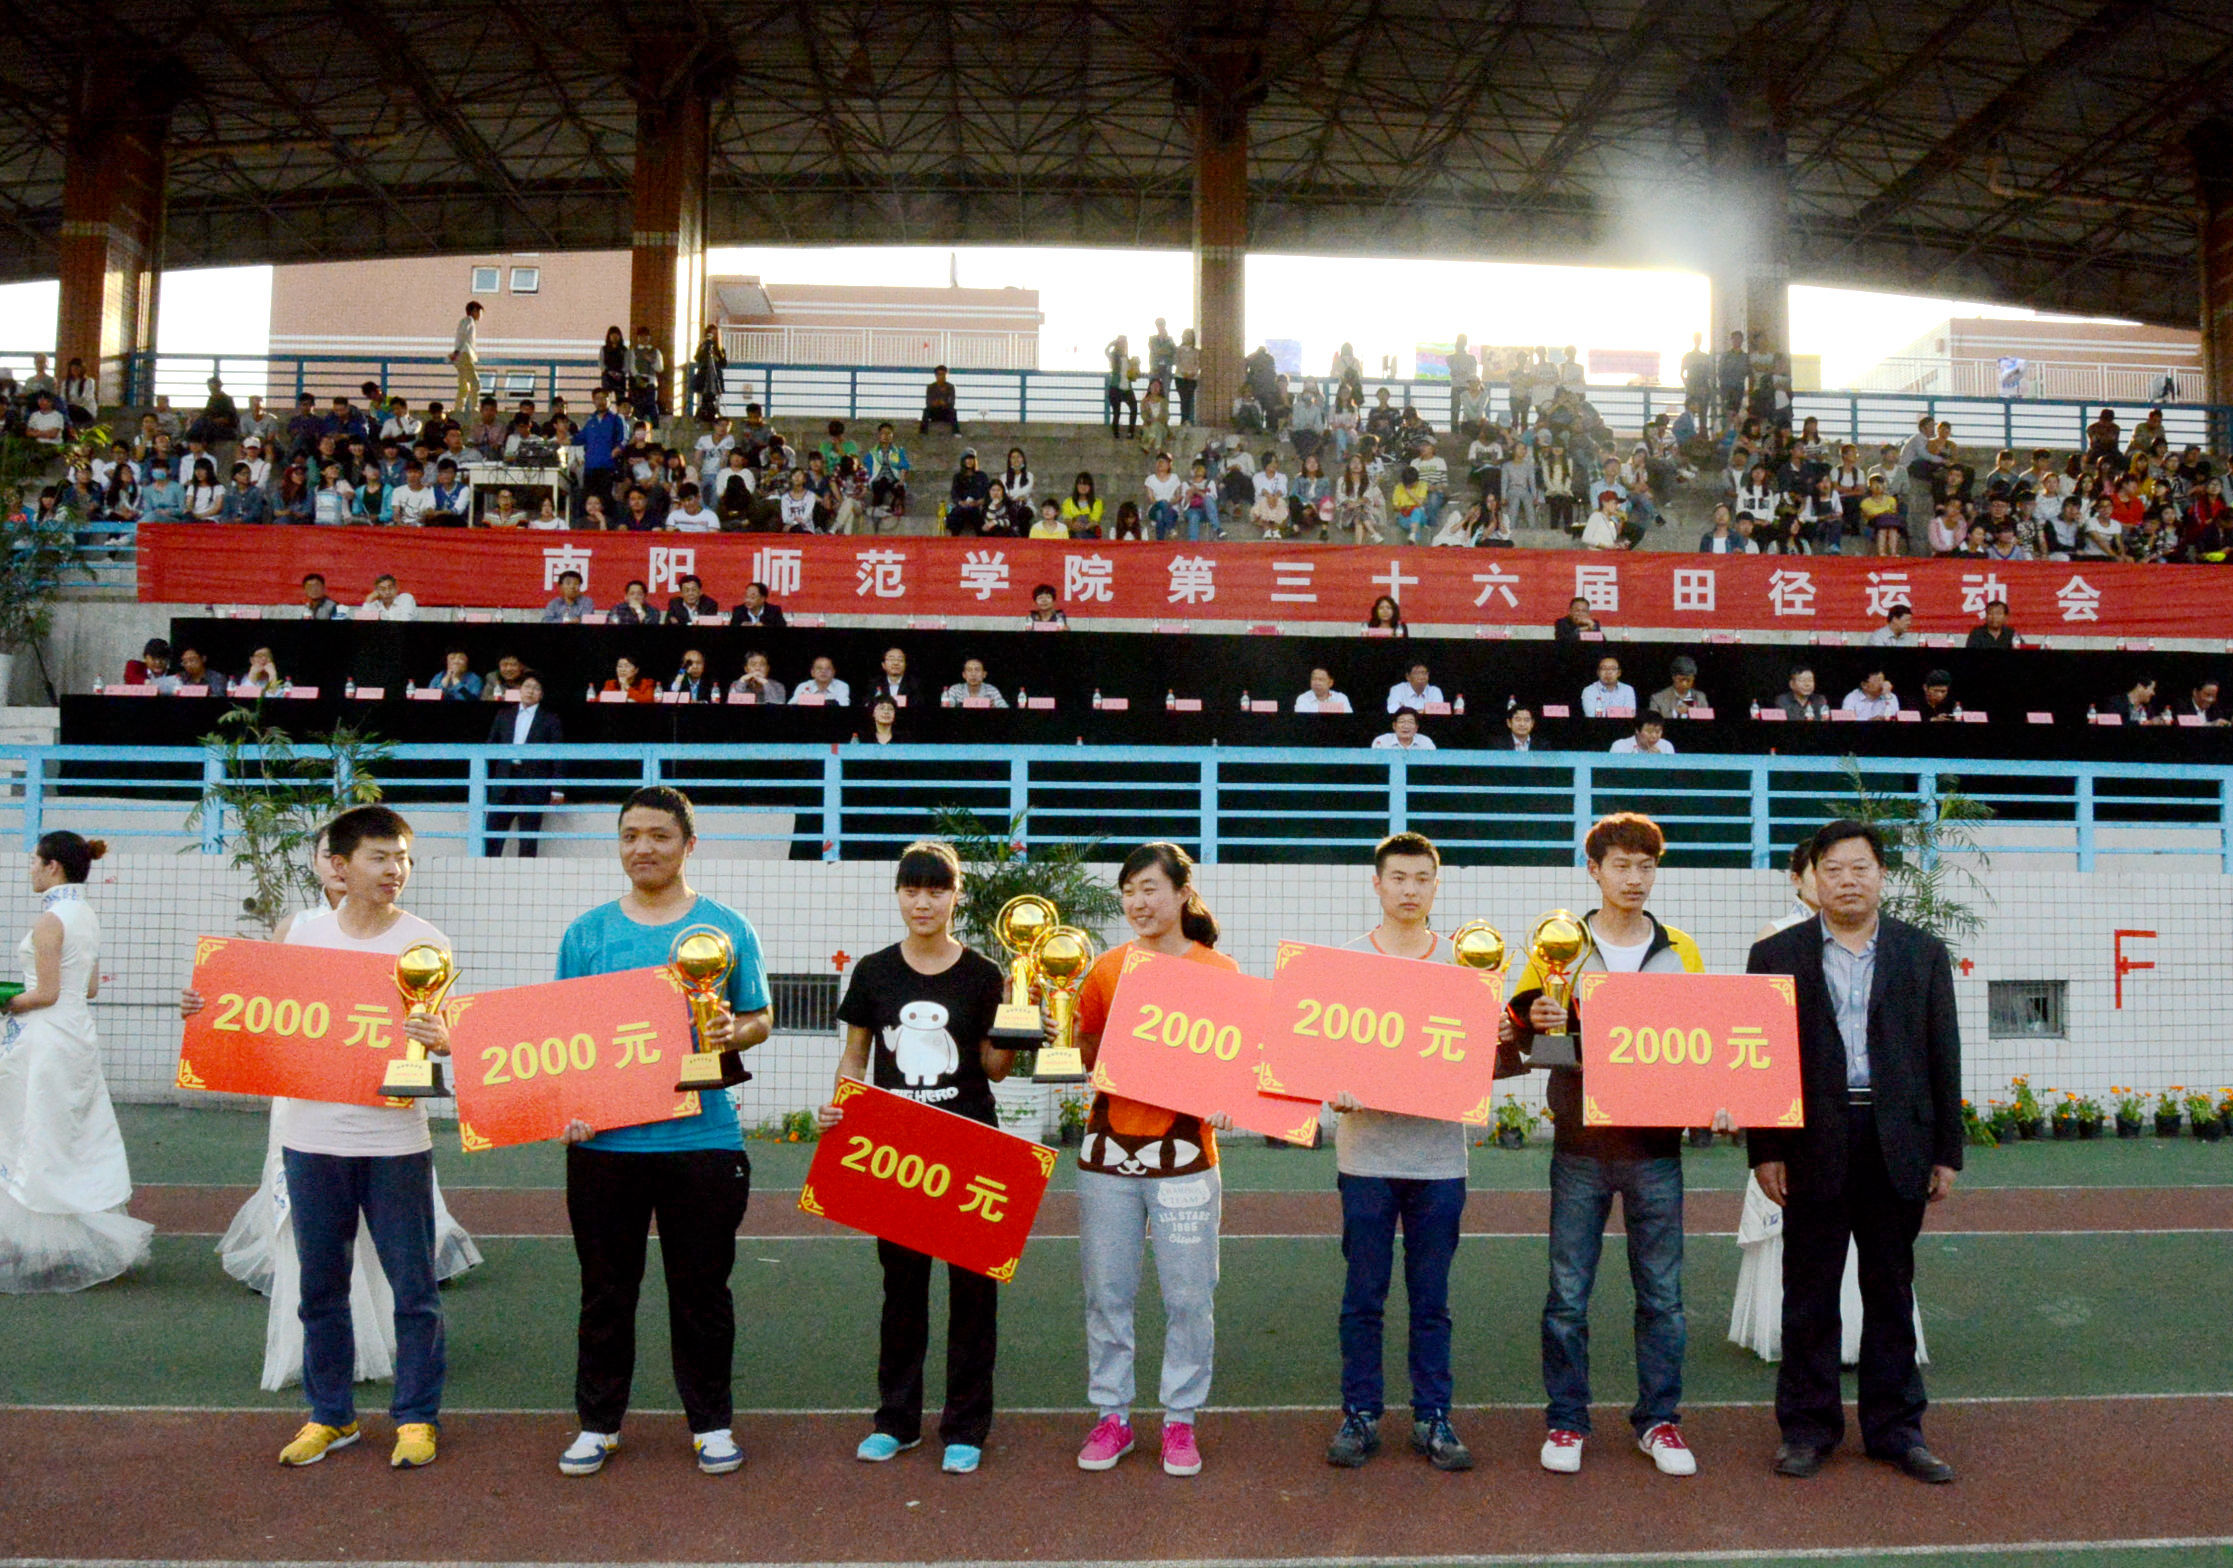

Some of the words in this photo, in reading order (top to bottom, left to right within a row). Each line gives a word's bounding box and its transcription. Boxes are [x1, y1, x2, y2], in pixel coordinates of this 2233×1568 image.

[543, 543, 2102, 622] 南阳师范学院第三十六届田径运动会
[2114, 929, 2157, 1009] F
[213, 993, 331, 1039] 2000
[344, 1004, 393, 1049] 元
[1133, 1004, 1243, 1061] 2000
[1293, 999, 1406, 1049] 2000
[1419, 1016, 1467, 1062] 元
[1609, 1026, 1713, 1065] 2000
[1727, 1026, 1772, 1070] 元
[482, 1033, 598, 1086] 2000
[613, 1021, 662, 1069] 元
[841, 1136, 951, 1197] 2000
[958, 1175, 1008, 1222] 元
